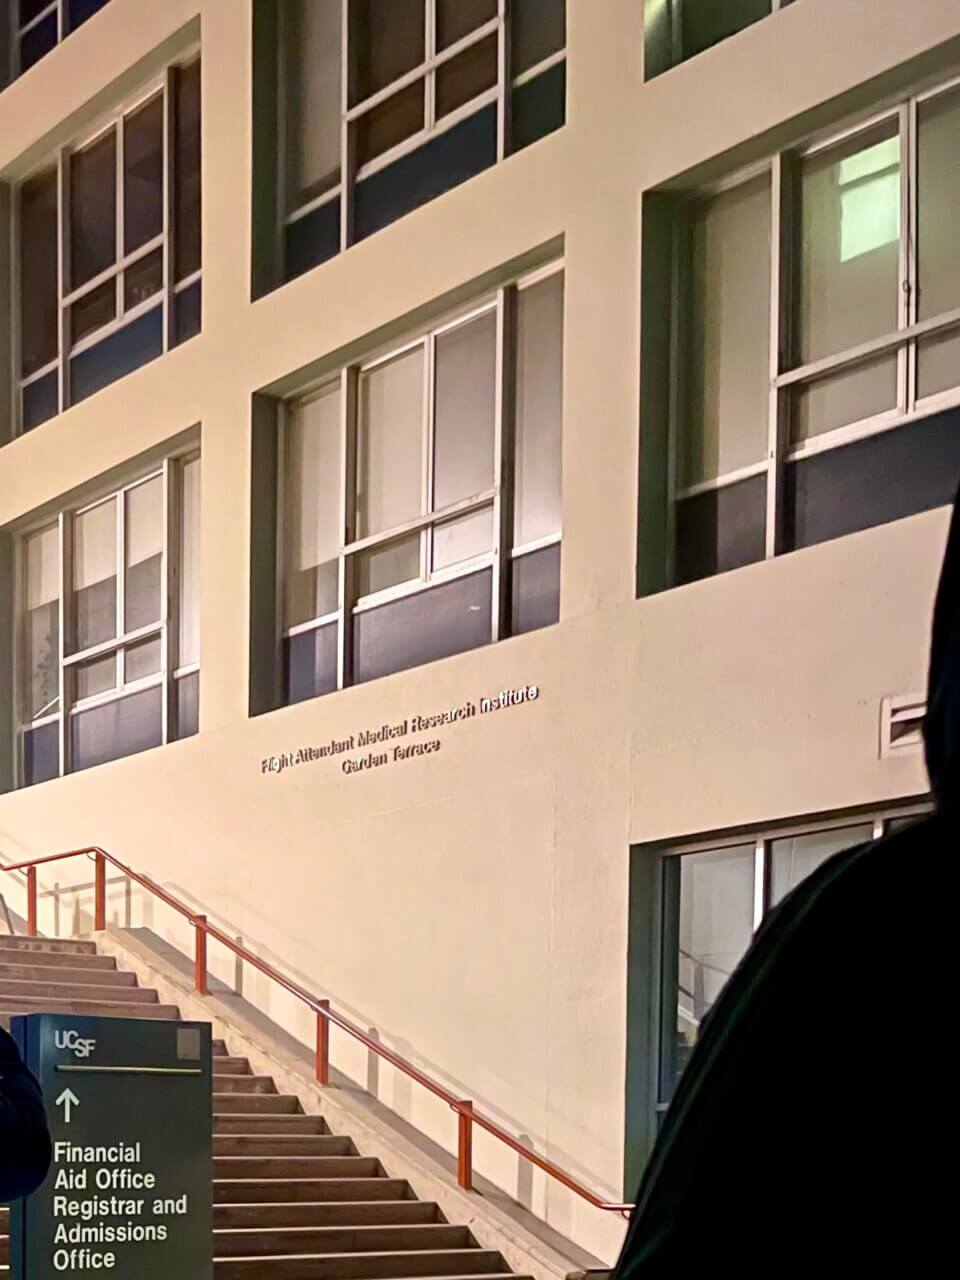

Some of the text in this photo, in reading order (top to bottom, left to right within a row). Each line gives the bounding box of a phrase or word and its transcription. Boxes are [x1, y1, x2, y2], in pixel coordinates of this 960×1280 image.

[295, 735, 355, 764] Attendant
[357, 720, 408, 747] Medical
[411, 702, 476, 732] Research
[480, 685, 539, 713] Institute
[342, 739, 441, 774] Garden Terrace
[54, 1029, 96, 1058] UCSF
[54, 1141, 141, 1164] Financial
[54, 1168, 155, 1190] Aid Office
[54, 1195, 187, 1220] Registrar and
[54, 1222, 168, 1244] Admissions
[53, 1249, 116, 1271] Office
